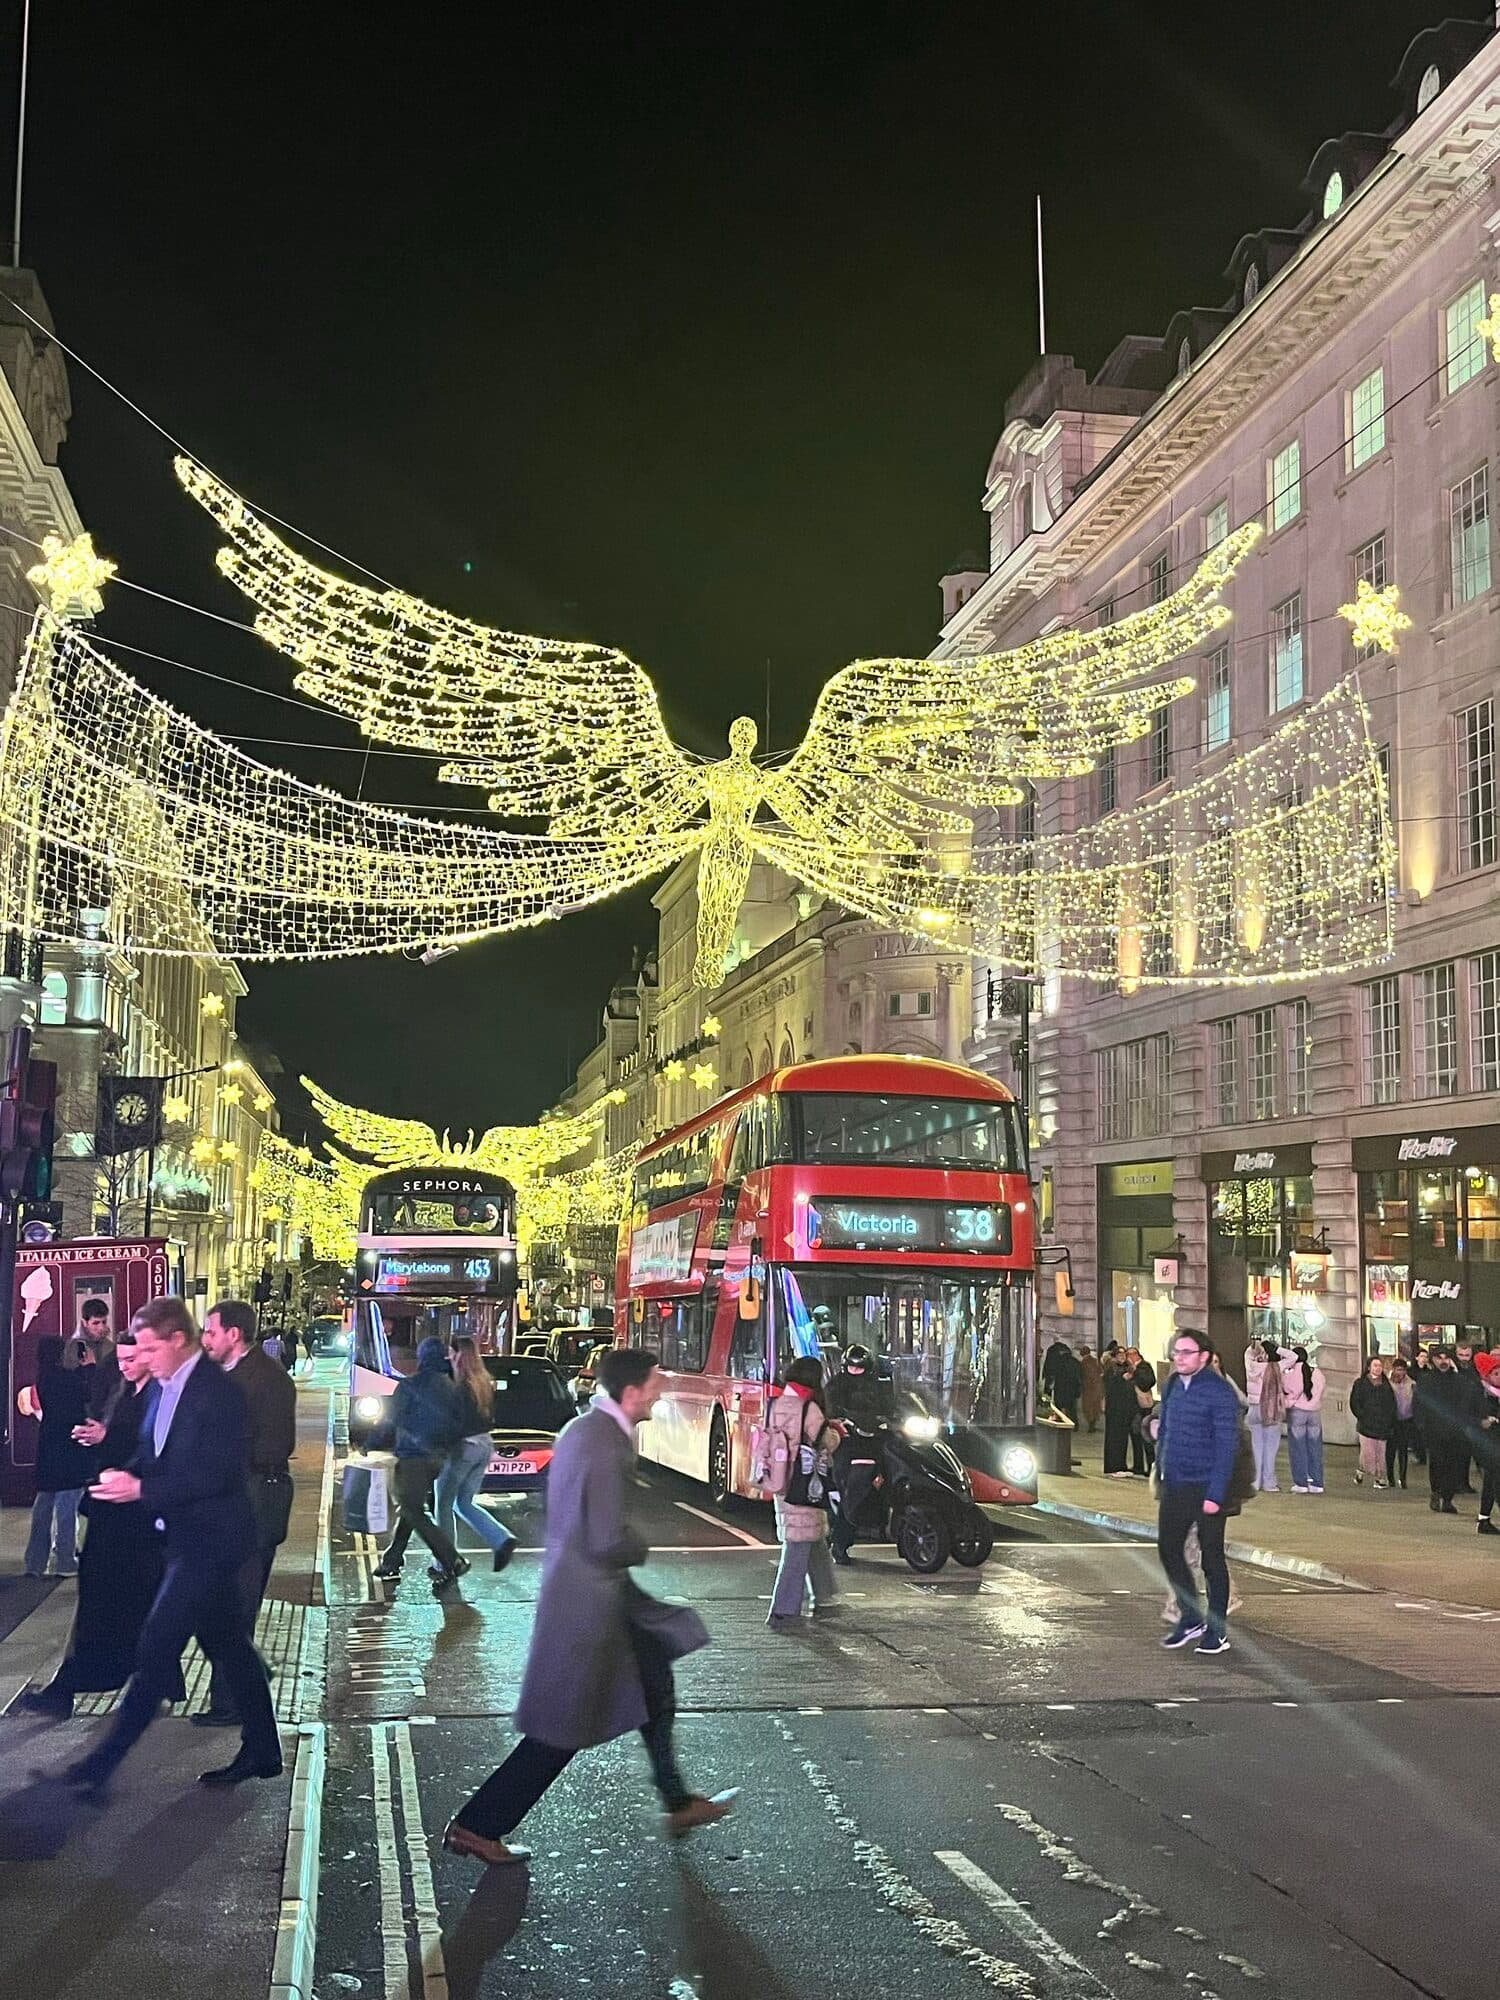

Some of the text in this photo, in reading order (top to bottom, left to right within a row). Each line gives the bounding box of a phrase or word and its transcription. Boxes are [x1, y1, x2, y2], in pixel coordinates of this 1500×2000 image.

[403, 1180, 483, 1192] SEPHORA
[838, 1208, 994, 1241] Victoria 38
[19, 1247, 141, 1262] ITALIAN ICE CREAM
[386, 1258, 491, 1278] Marylebone 453
